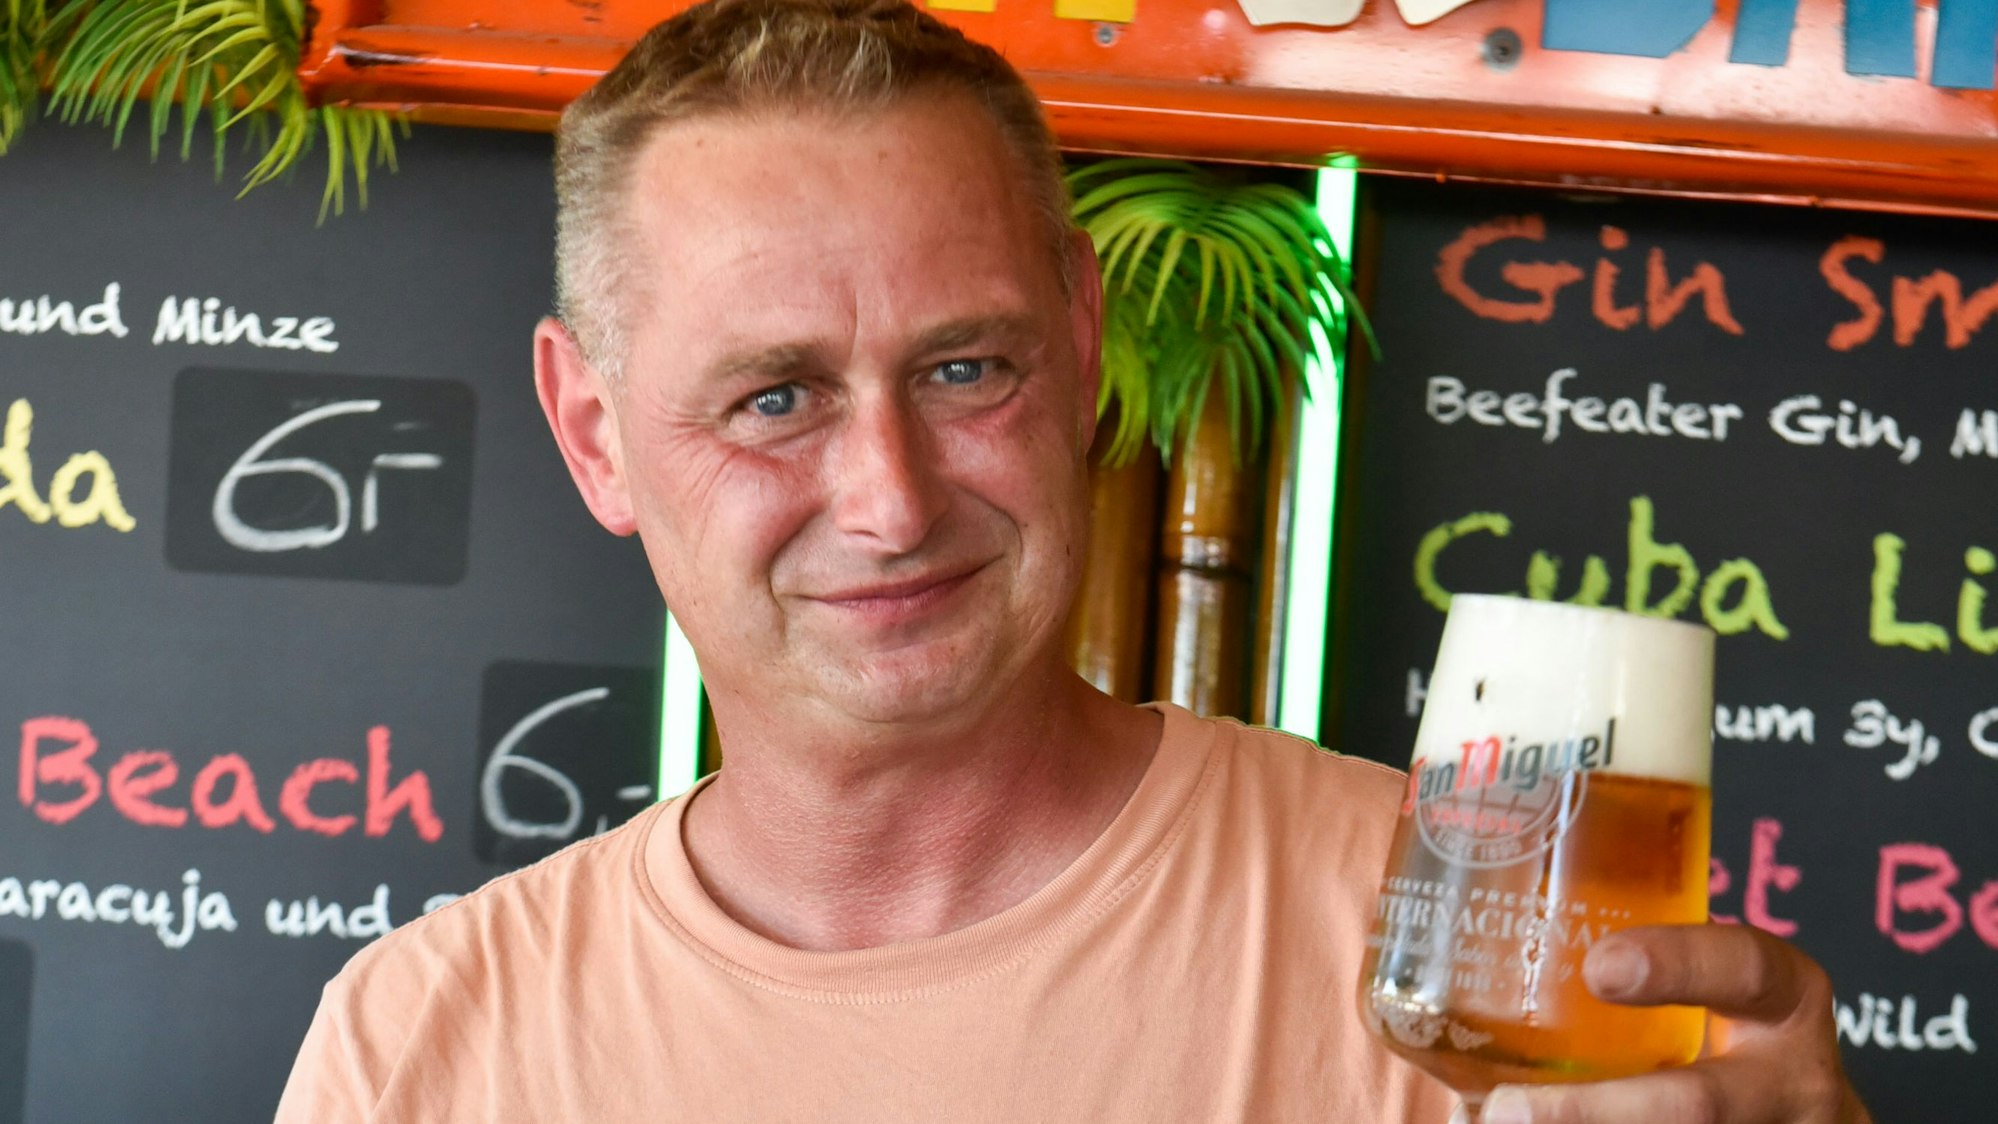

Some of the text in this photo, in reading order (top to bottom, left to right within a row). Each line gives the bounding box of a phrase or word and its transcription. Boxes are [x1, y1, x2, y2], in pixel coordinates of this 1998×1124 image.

[0, 282, 339, 353] und Minze
[1435, 214, 1743, 336] Gin
[1427, 368, 1743, 442] Beefeater
[1769, 395, 1921, 464] Gin,
[1414, 495, 1998, 655] Cuba Li
[17, 715, 443, 843] Beach
[1843, 699, 1940, 780] 3y,
[0, 869, 398, 948] aracuja und
[1834, 993, 1975, 1052] Wild
